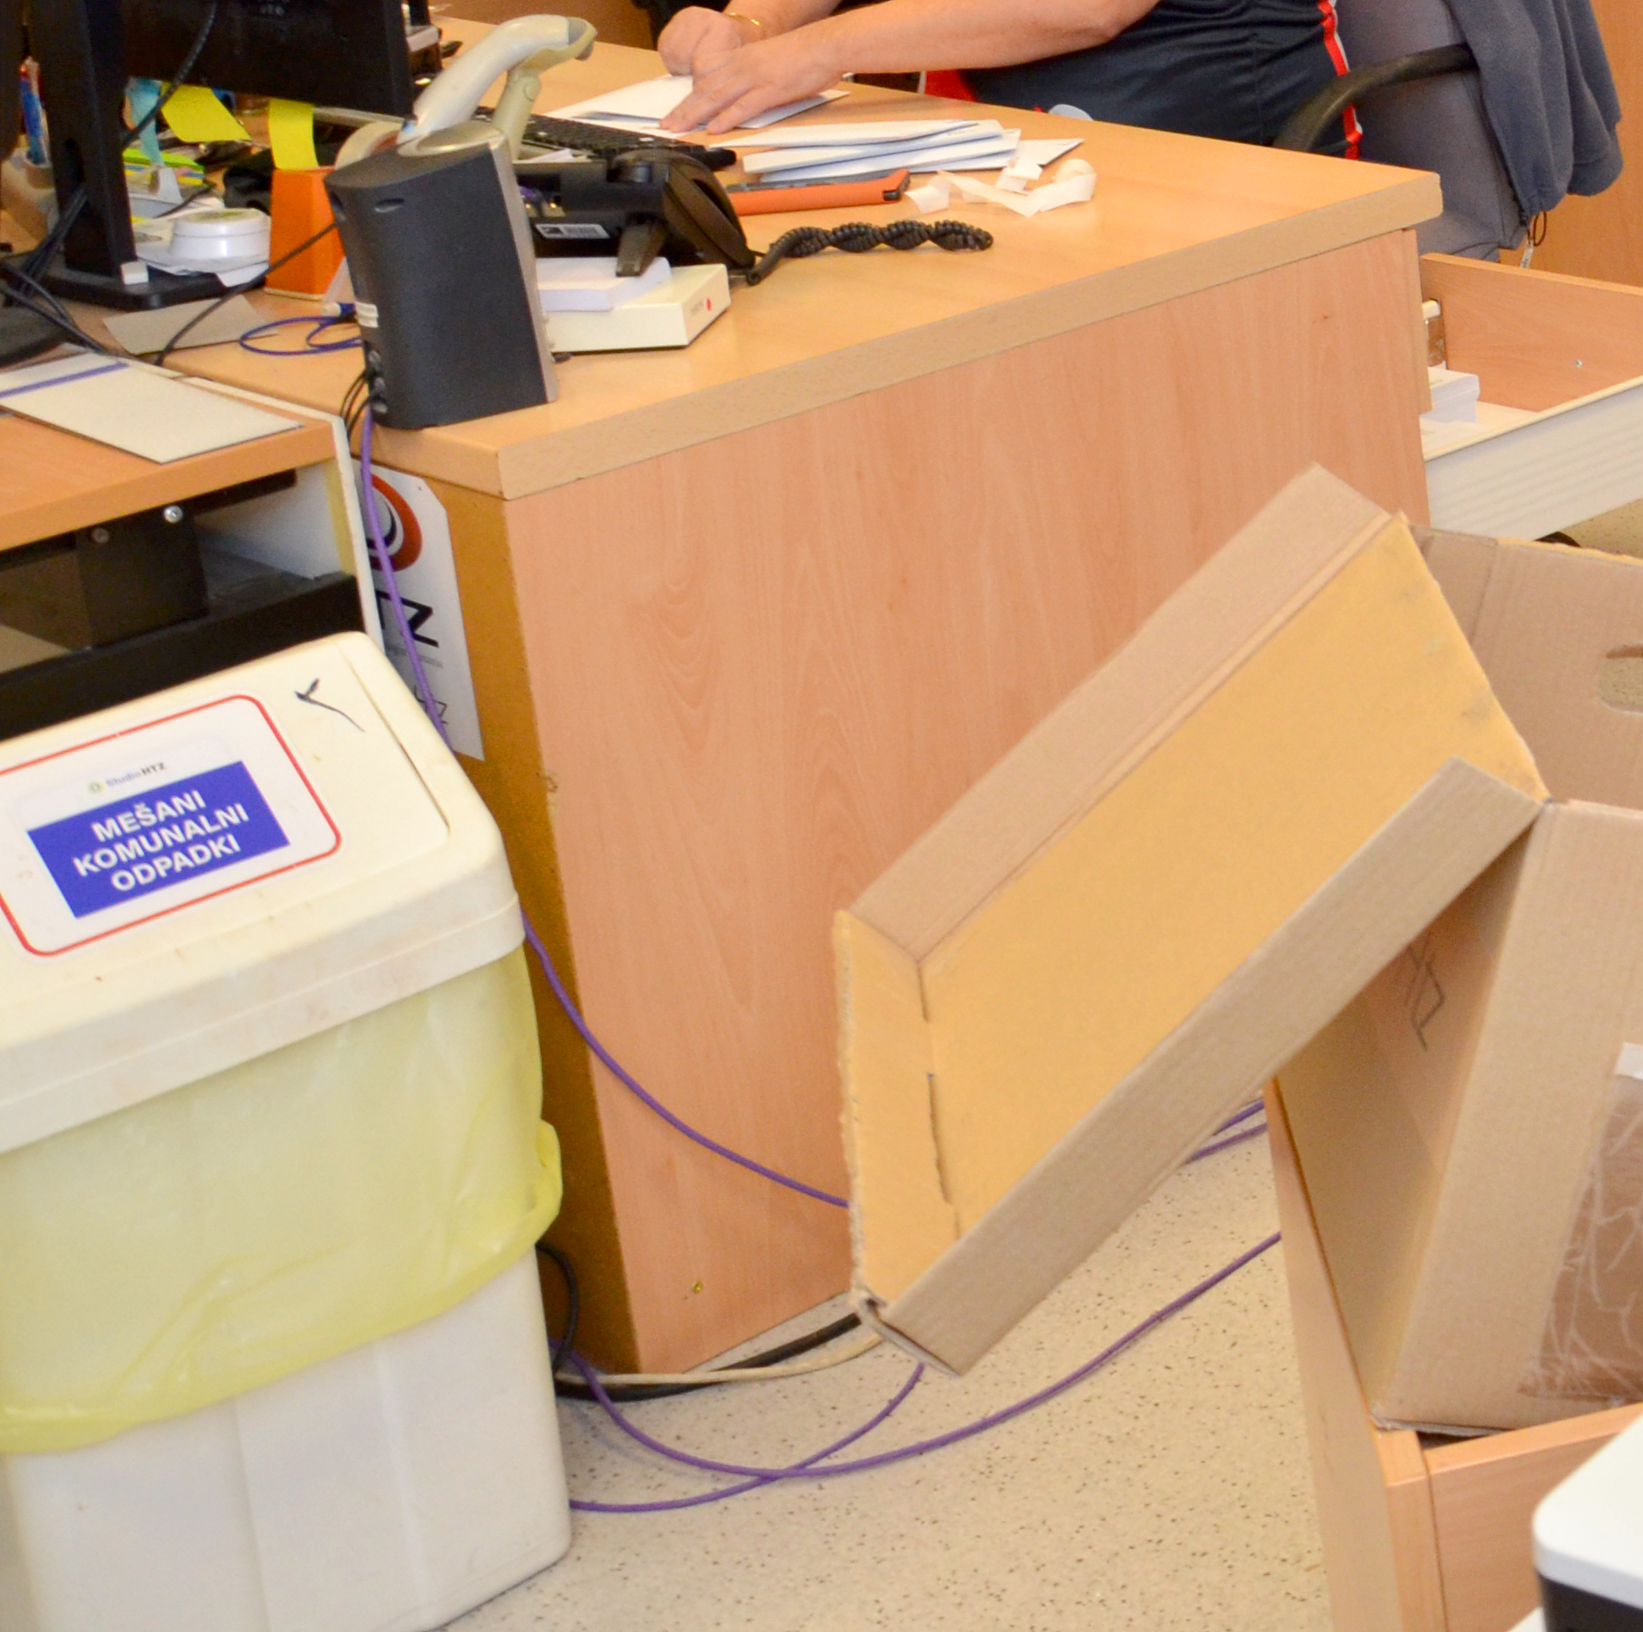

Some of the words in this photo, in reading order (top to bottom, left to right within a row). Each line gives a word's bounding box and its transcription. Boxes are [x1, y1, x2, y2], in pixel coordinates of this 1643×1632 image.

[72, 802, 250, 878] KOMUNALNI
[91, 789, 207, 843] MEŠANI
[110, 833, 242, 892] ODPADKI
